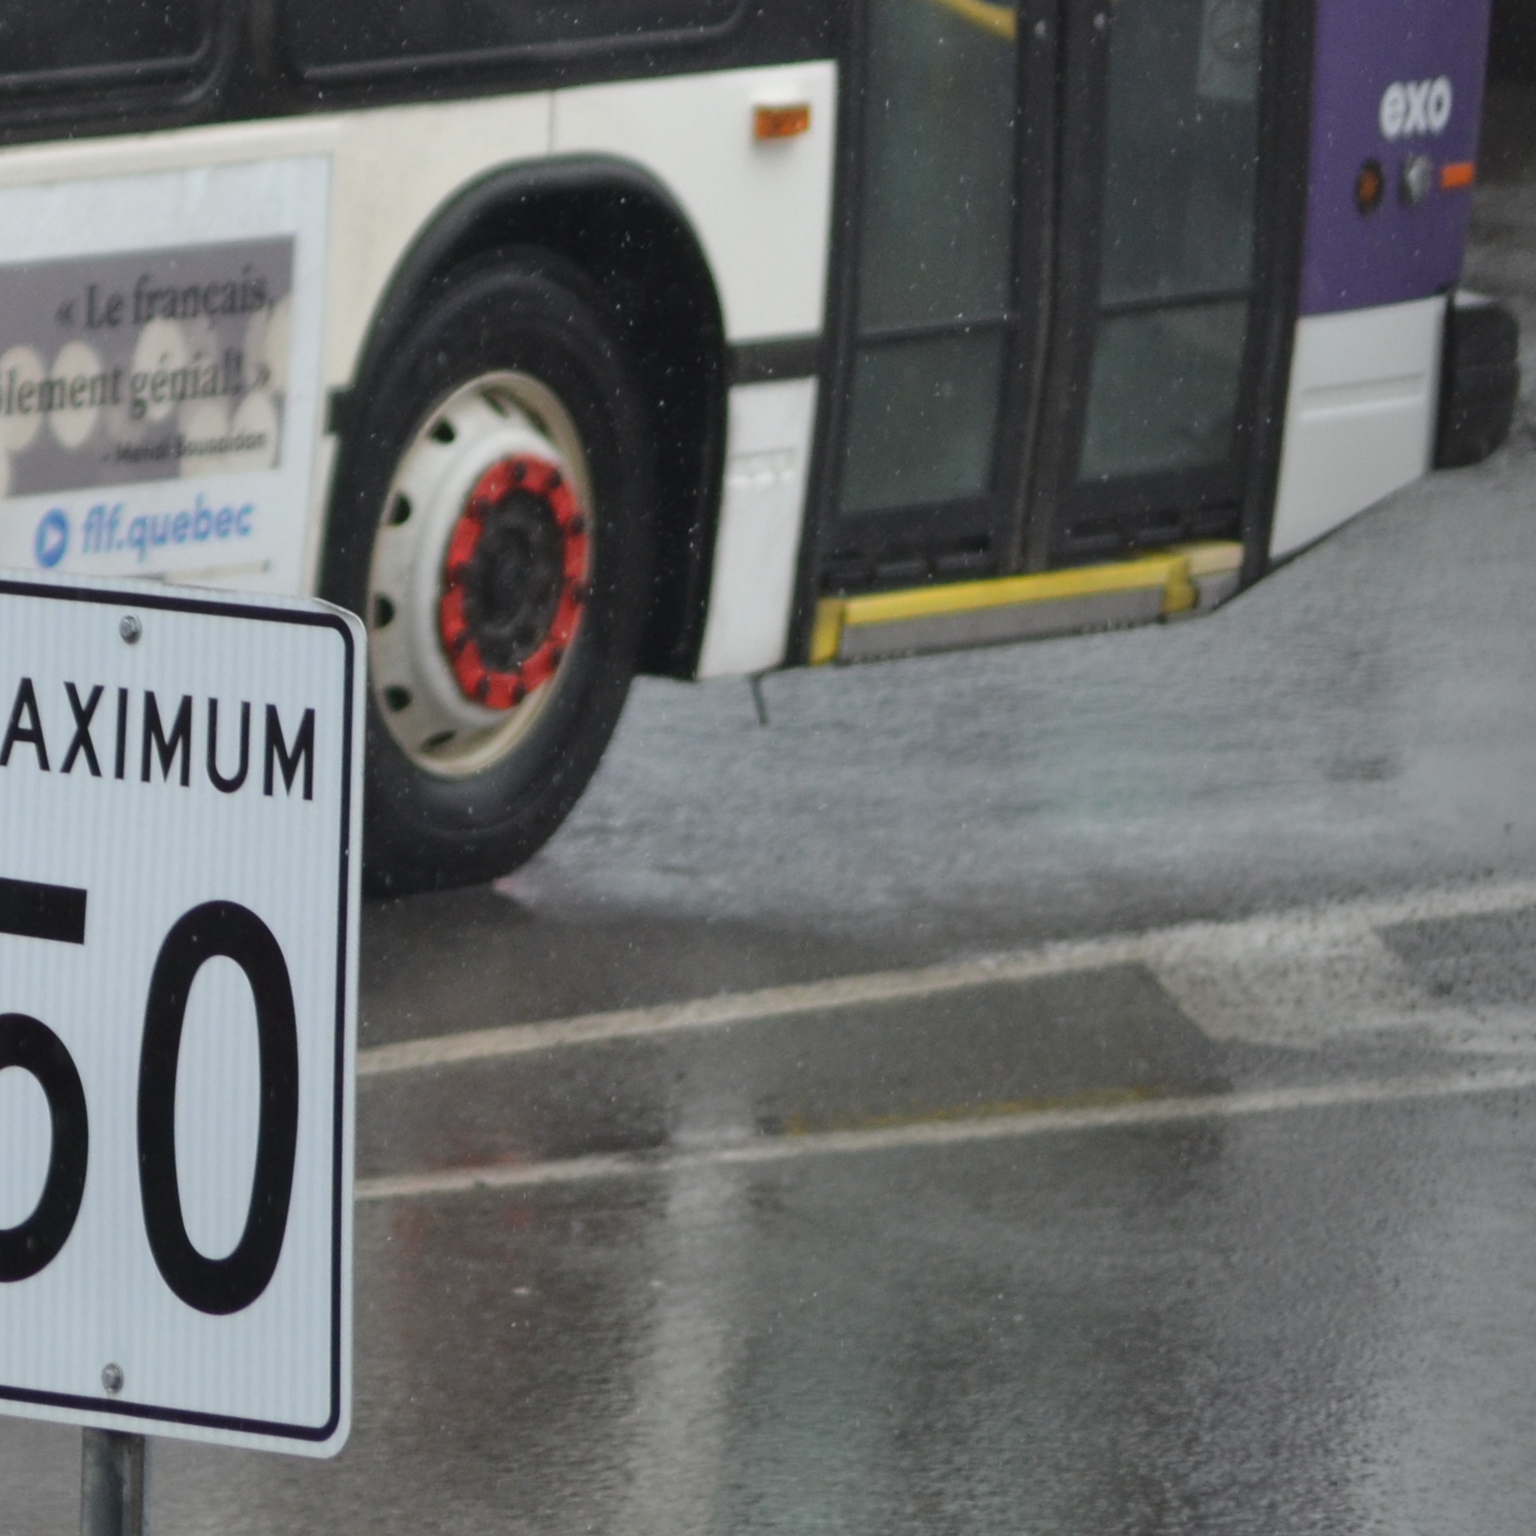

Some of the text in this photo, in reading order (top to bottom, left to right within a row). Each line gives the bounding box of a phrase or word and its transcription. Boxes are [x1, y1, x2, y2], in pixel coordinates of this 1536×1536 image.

[1380, 74, 1452, 142] exo
[84, 283, 125, 329] Le
[132, 264, 274, 329] français,
[131, 347, 245, 419] génial!
[81, 494, 255, 561] flf.quebec
